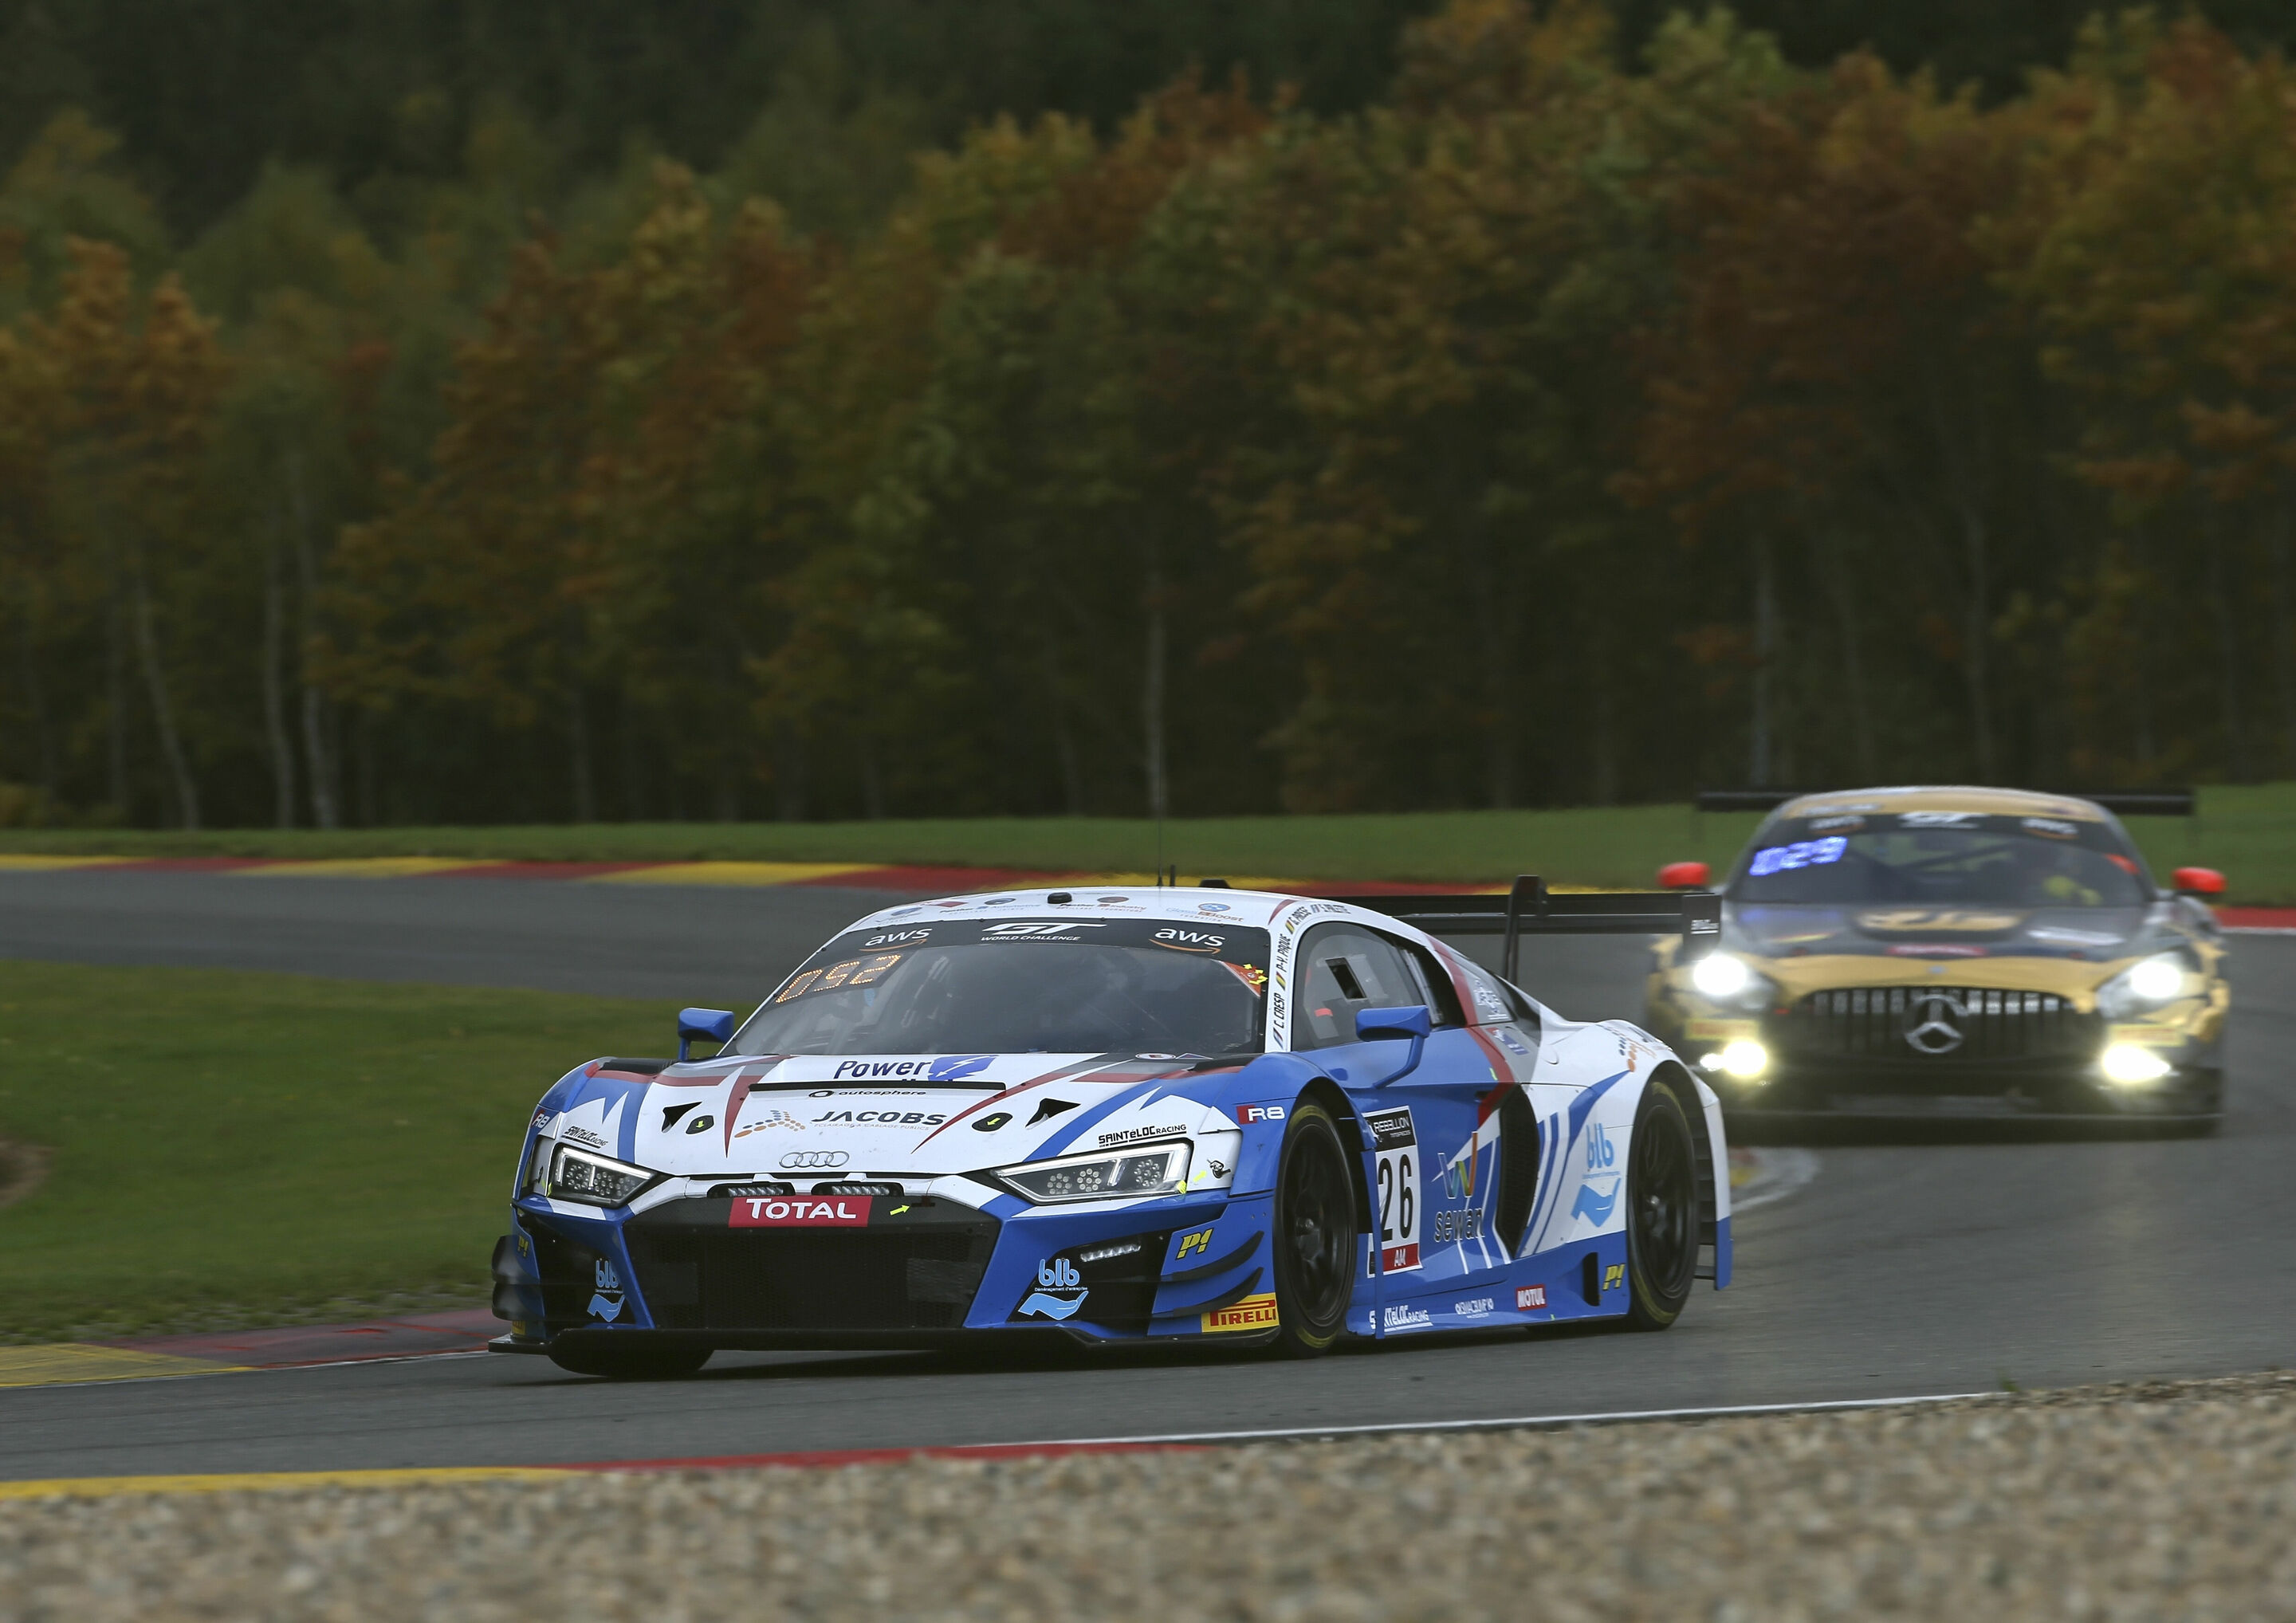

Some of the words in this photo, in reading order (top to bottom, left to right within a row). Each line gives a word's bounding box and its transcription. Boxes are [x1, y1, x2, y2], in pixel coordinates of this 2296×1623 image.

[865, 928, 933, 947] aws
[981, 922, 1107, 935] GT
[1154, 927, 1226, 947] aws
[1274, 992, 1285, 1018] CRESP
[1274, 1020, 1285, 1029] C.
[833, 1060, 932, 1079] Power
[811, 1110, 947, 1126] JACOBS
[1248, 1106, 1285, 1122] R8
[1373, 1117, 1410, 1134] REBELLION
[1586, 1122, 1614, 1169] blb
[1378, 1153, 1413, 1243] 26
[745, 1198, 857, 1220] TOTAL
[1434, 1207, 1485, 1243] sewan
[1394, 1248, 1406, 1267] AM
[595, 1259, 619, 1288] blb
[1039, 1259, 1080, 1287] blb
[1517, 1287, 1546, 1308] MOTUL
